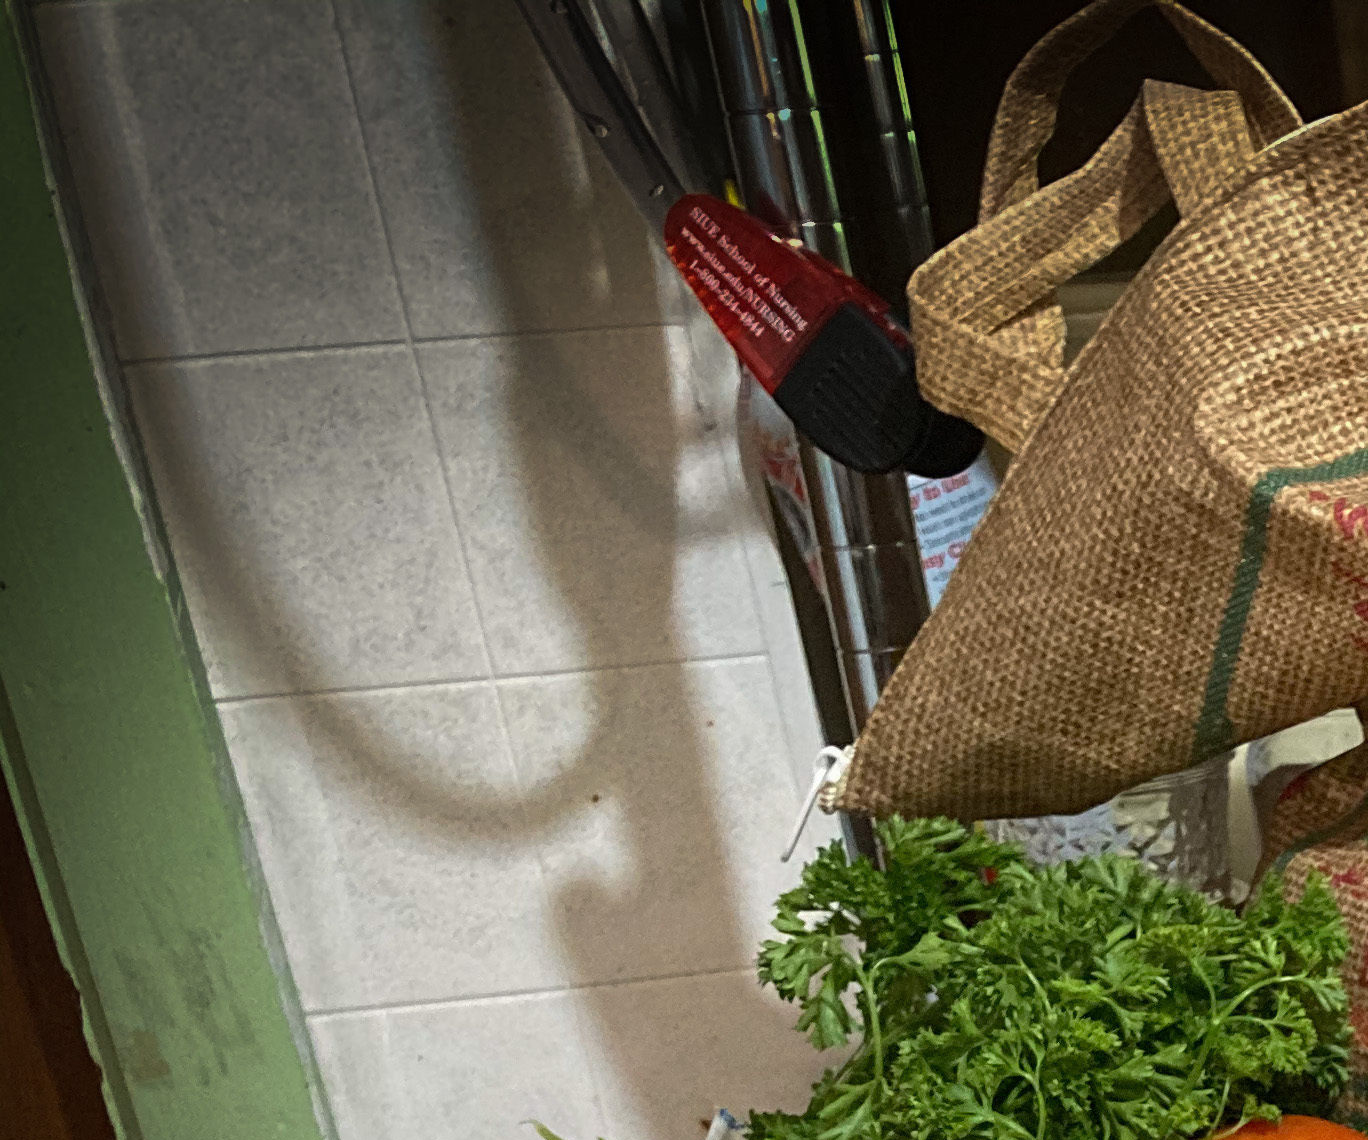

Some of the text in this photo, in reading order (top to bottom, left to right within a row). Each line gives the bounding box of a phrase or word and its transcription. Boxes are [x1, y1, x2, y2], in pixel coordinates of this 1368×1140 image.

[717, 234, 757, 274] School
[754, 273, 770, 288] of
[766, 283, 808, 331] Nursing
